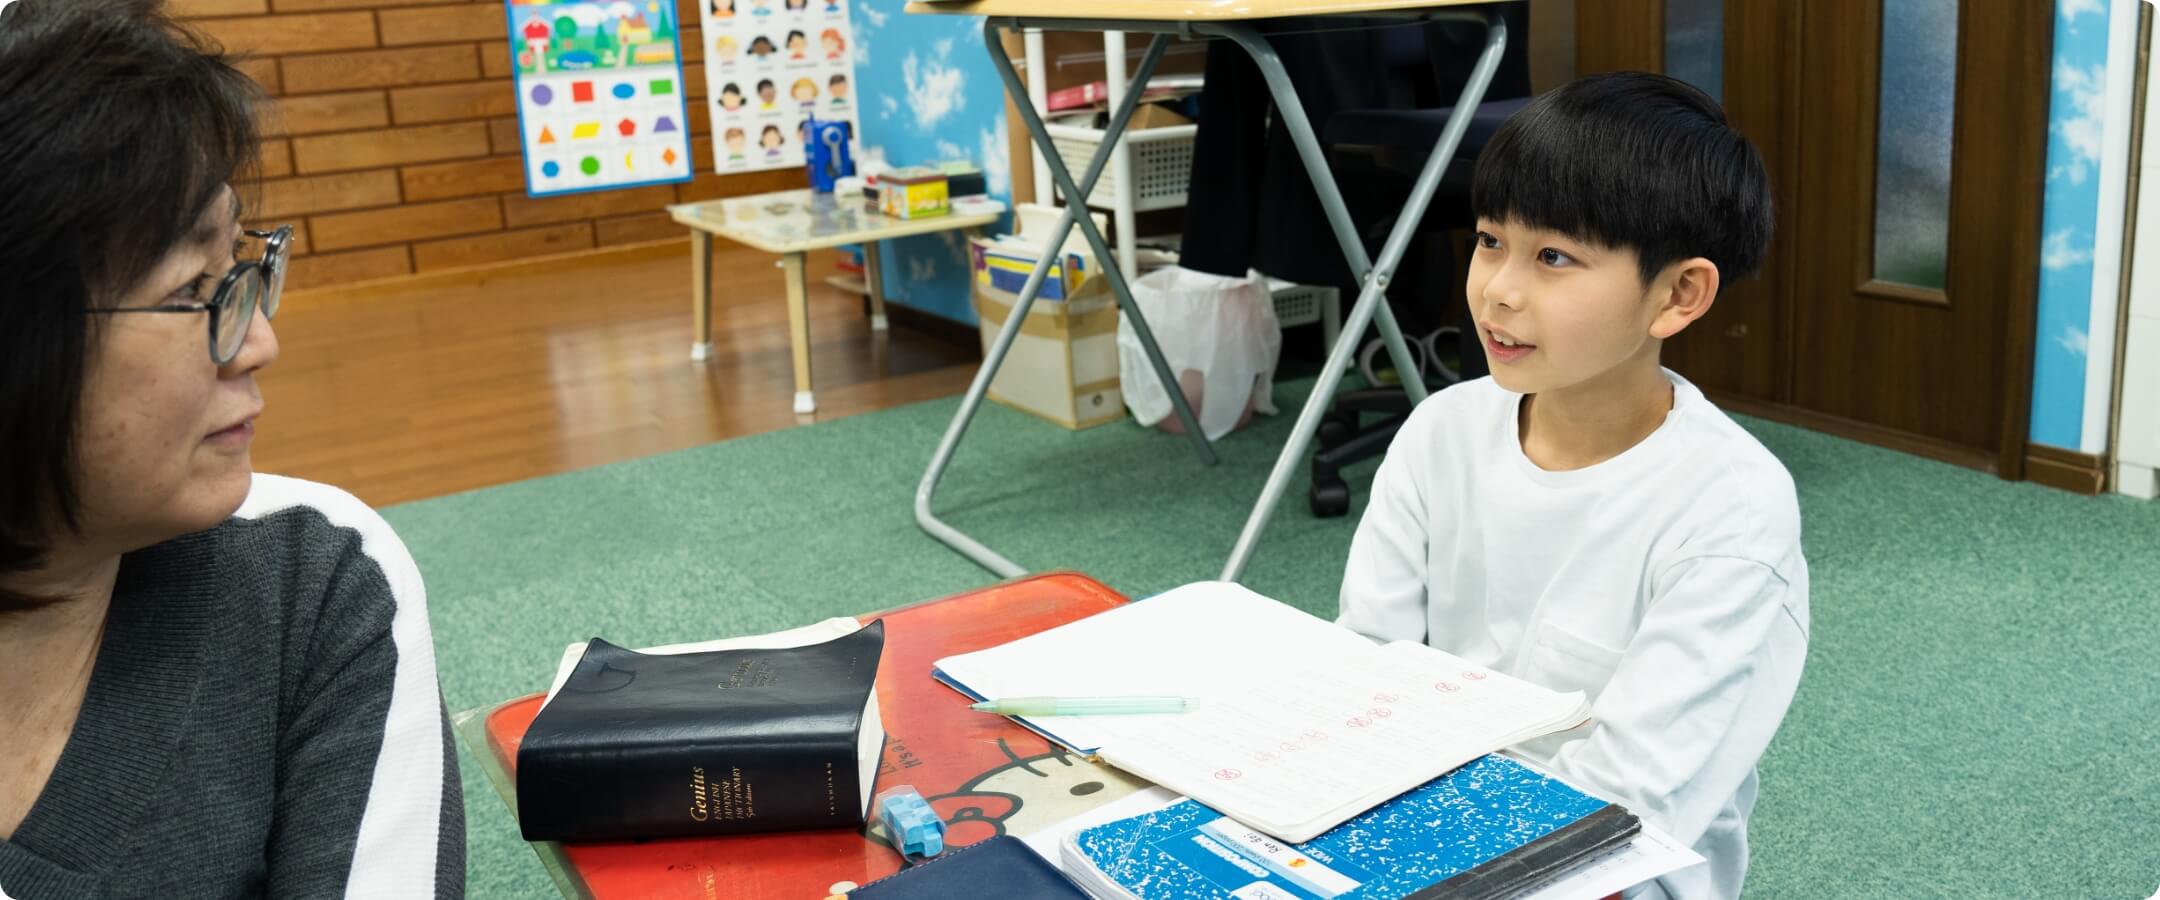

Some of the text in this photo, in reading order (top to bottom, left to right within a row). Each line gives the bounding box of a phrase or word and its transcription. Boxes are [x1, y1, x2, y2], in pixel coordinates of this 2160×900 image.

[690, 766, 708, 821] Genius
[711, 782, 722, 820] ENGLISH
[721, 779, 734, 820] JAPANESE
[732, 765, 744, 819] DICTIONARY
[1191, 834, 1270, 878] COMPOSITION
[1304, 846, 1335, 865] WIDE
